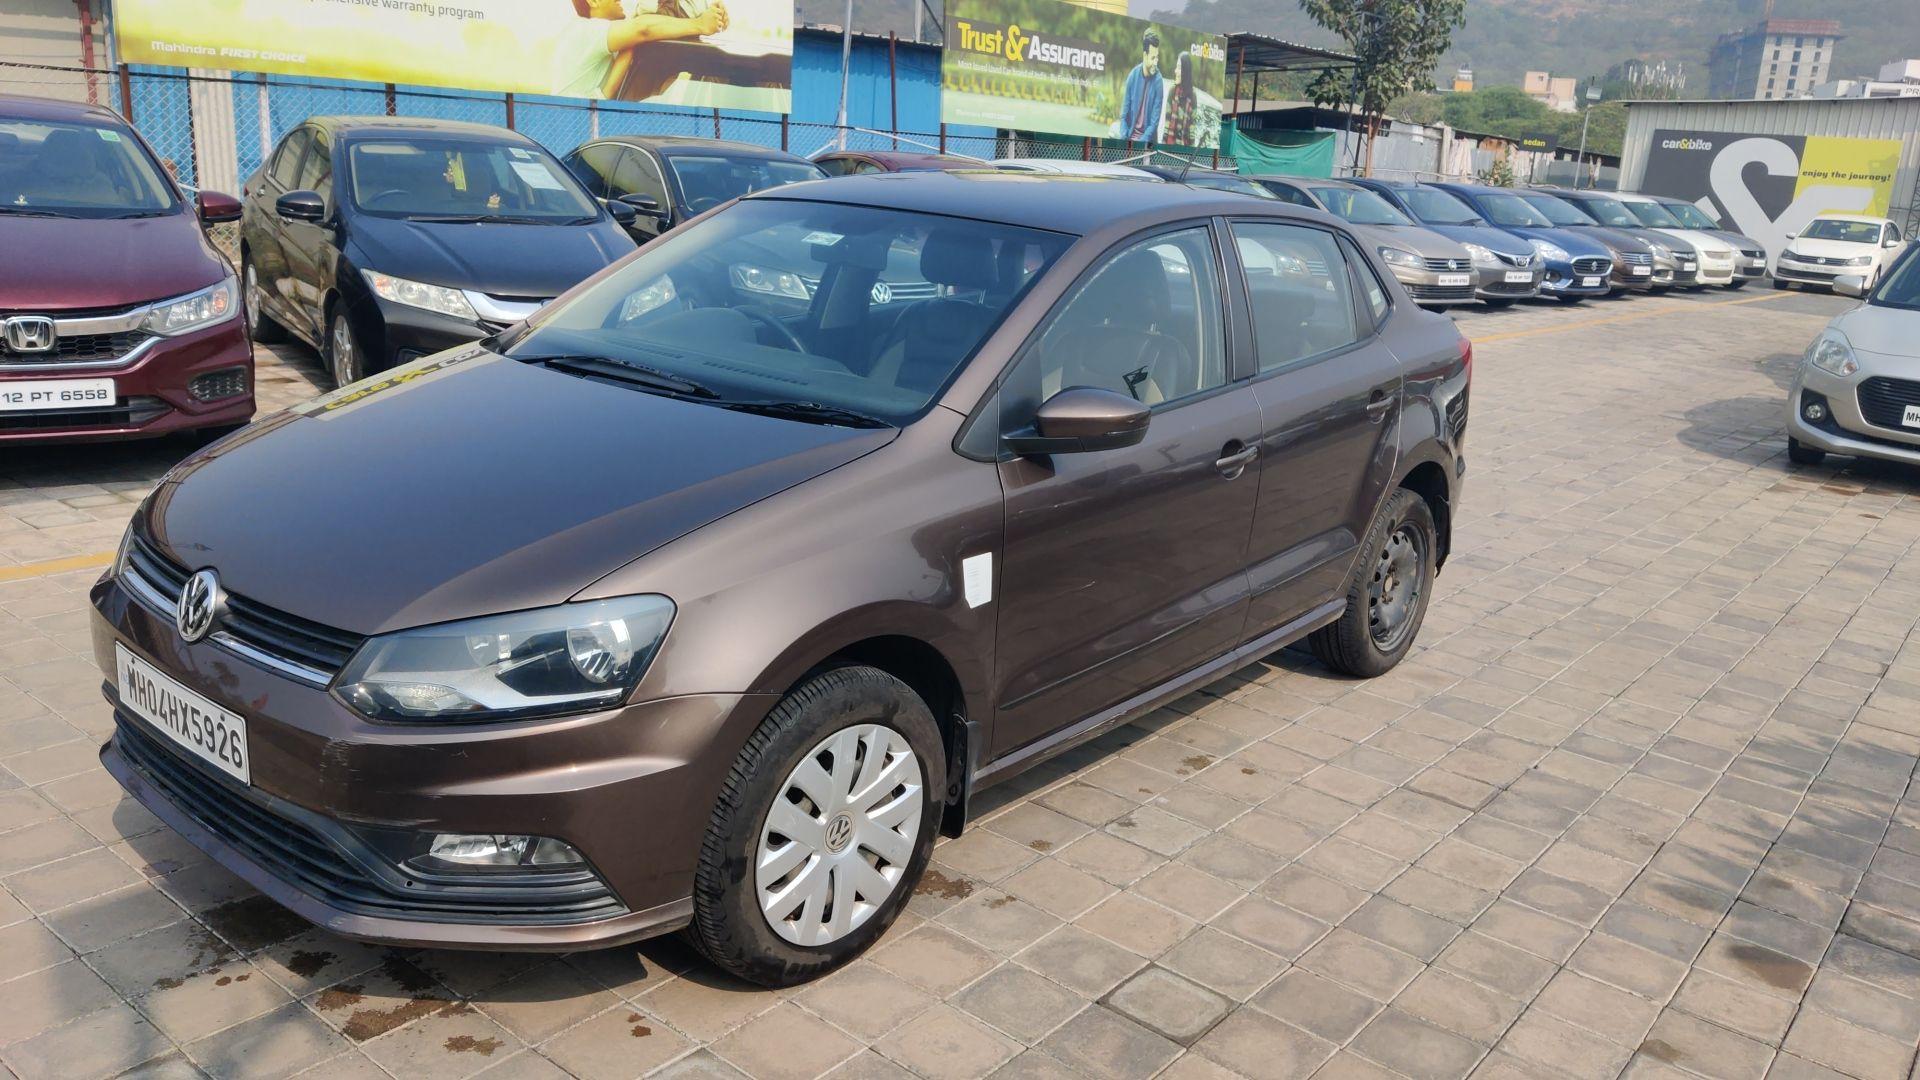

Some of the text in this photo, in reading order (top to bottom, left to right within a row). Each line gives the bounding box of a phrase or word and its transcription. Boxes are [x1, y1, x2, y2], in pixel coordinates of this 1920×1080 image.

[382, 0, 484, 20] warranty program
[151, 40, 307, 64] Mahindra FIRST CHOICE
[958, 22, 1105, 70] Trust & Assurance
[1523, 138, 1546, 147] sedan
[1662, 138, 1713, 151] car&bike
[1802, 170, 1891, 182] enjoy the journey!
[2, 389, 108, 403] 12 PT 6558
[127, 663, 243, 769] MH04HX5926
